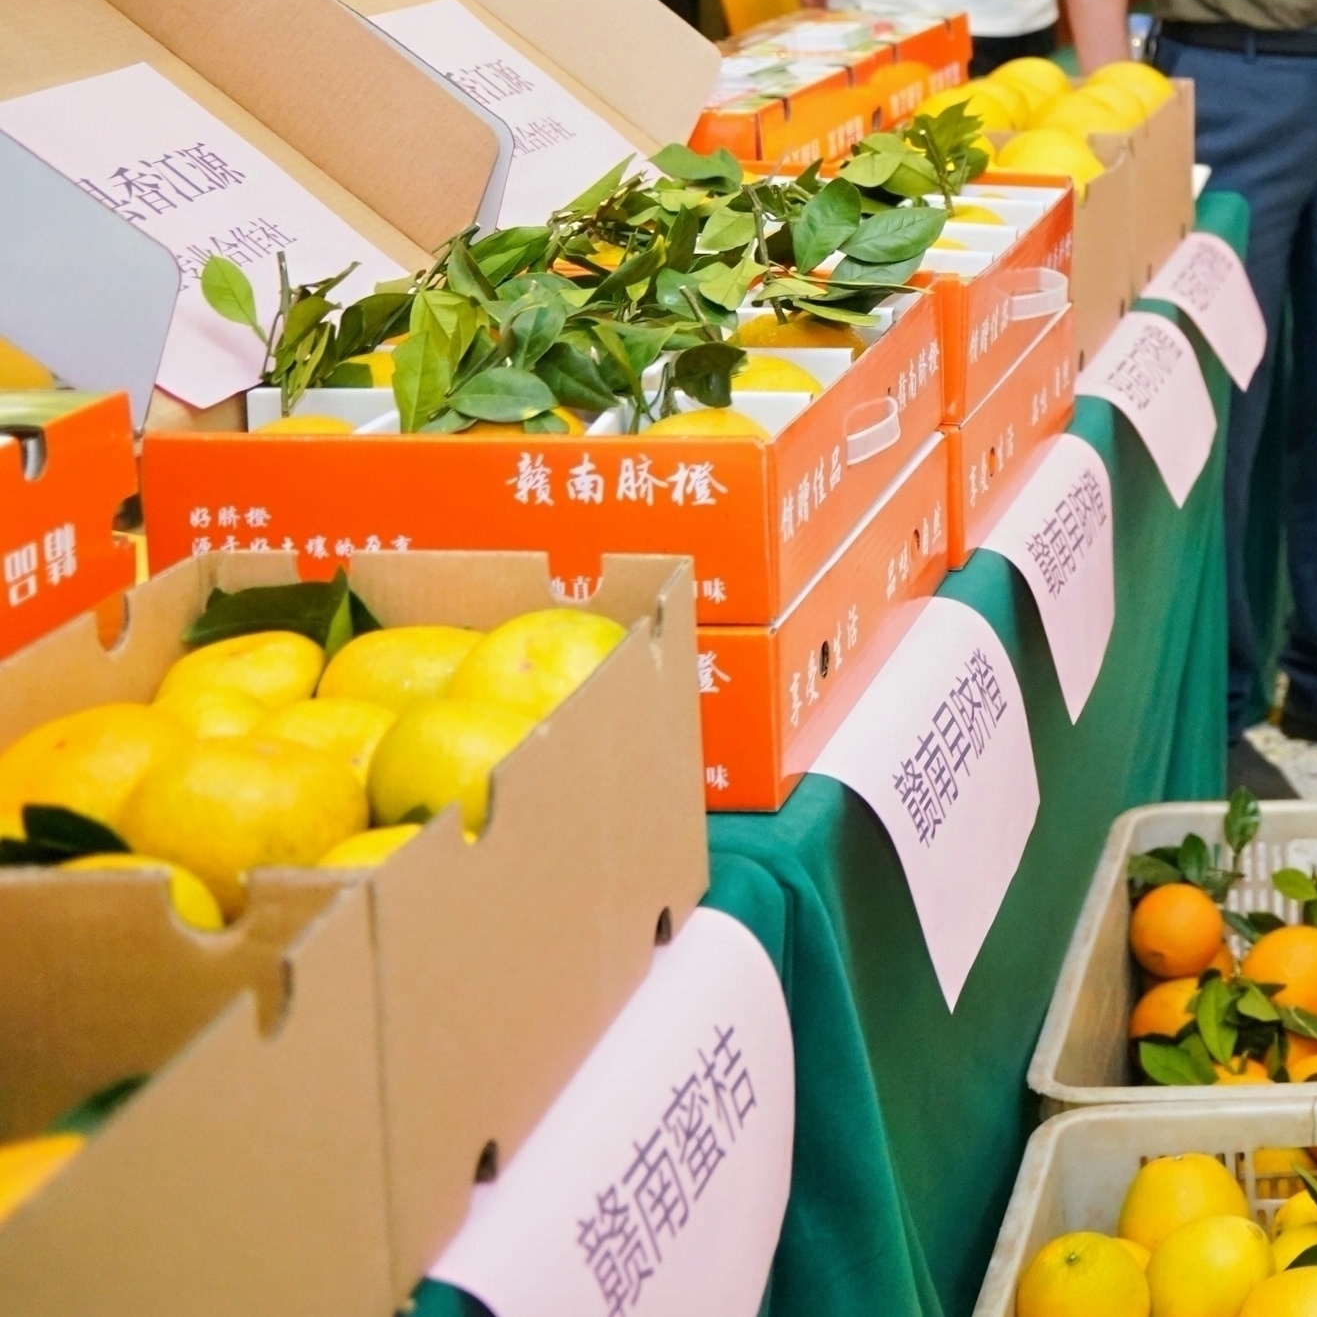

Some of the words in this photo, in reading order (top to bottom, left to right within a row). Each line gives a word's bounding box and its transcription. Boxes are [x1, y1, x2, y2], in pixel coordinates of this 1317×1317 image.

[189, 505, 272, 530] 好脐橙
[505, 451, 729, 506] 赣南脐橙
[1025, 467, 1107, 601] 赣南早脐橙
[891, 647, 1008, 850] 赣南早脐橙
[576, 1024, 757, 1317] 赣南蜜桔
